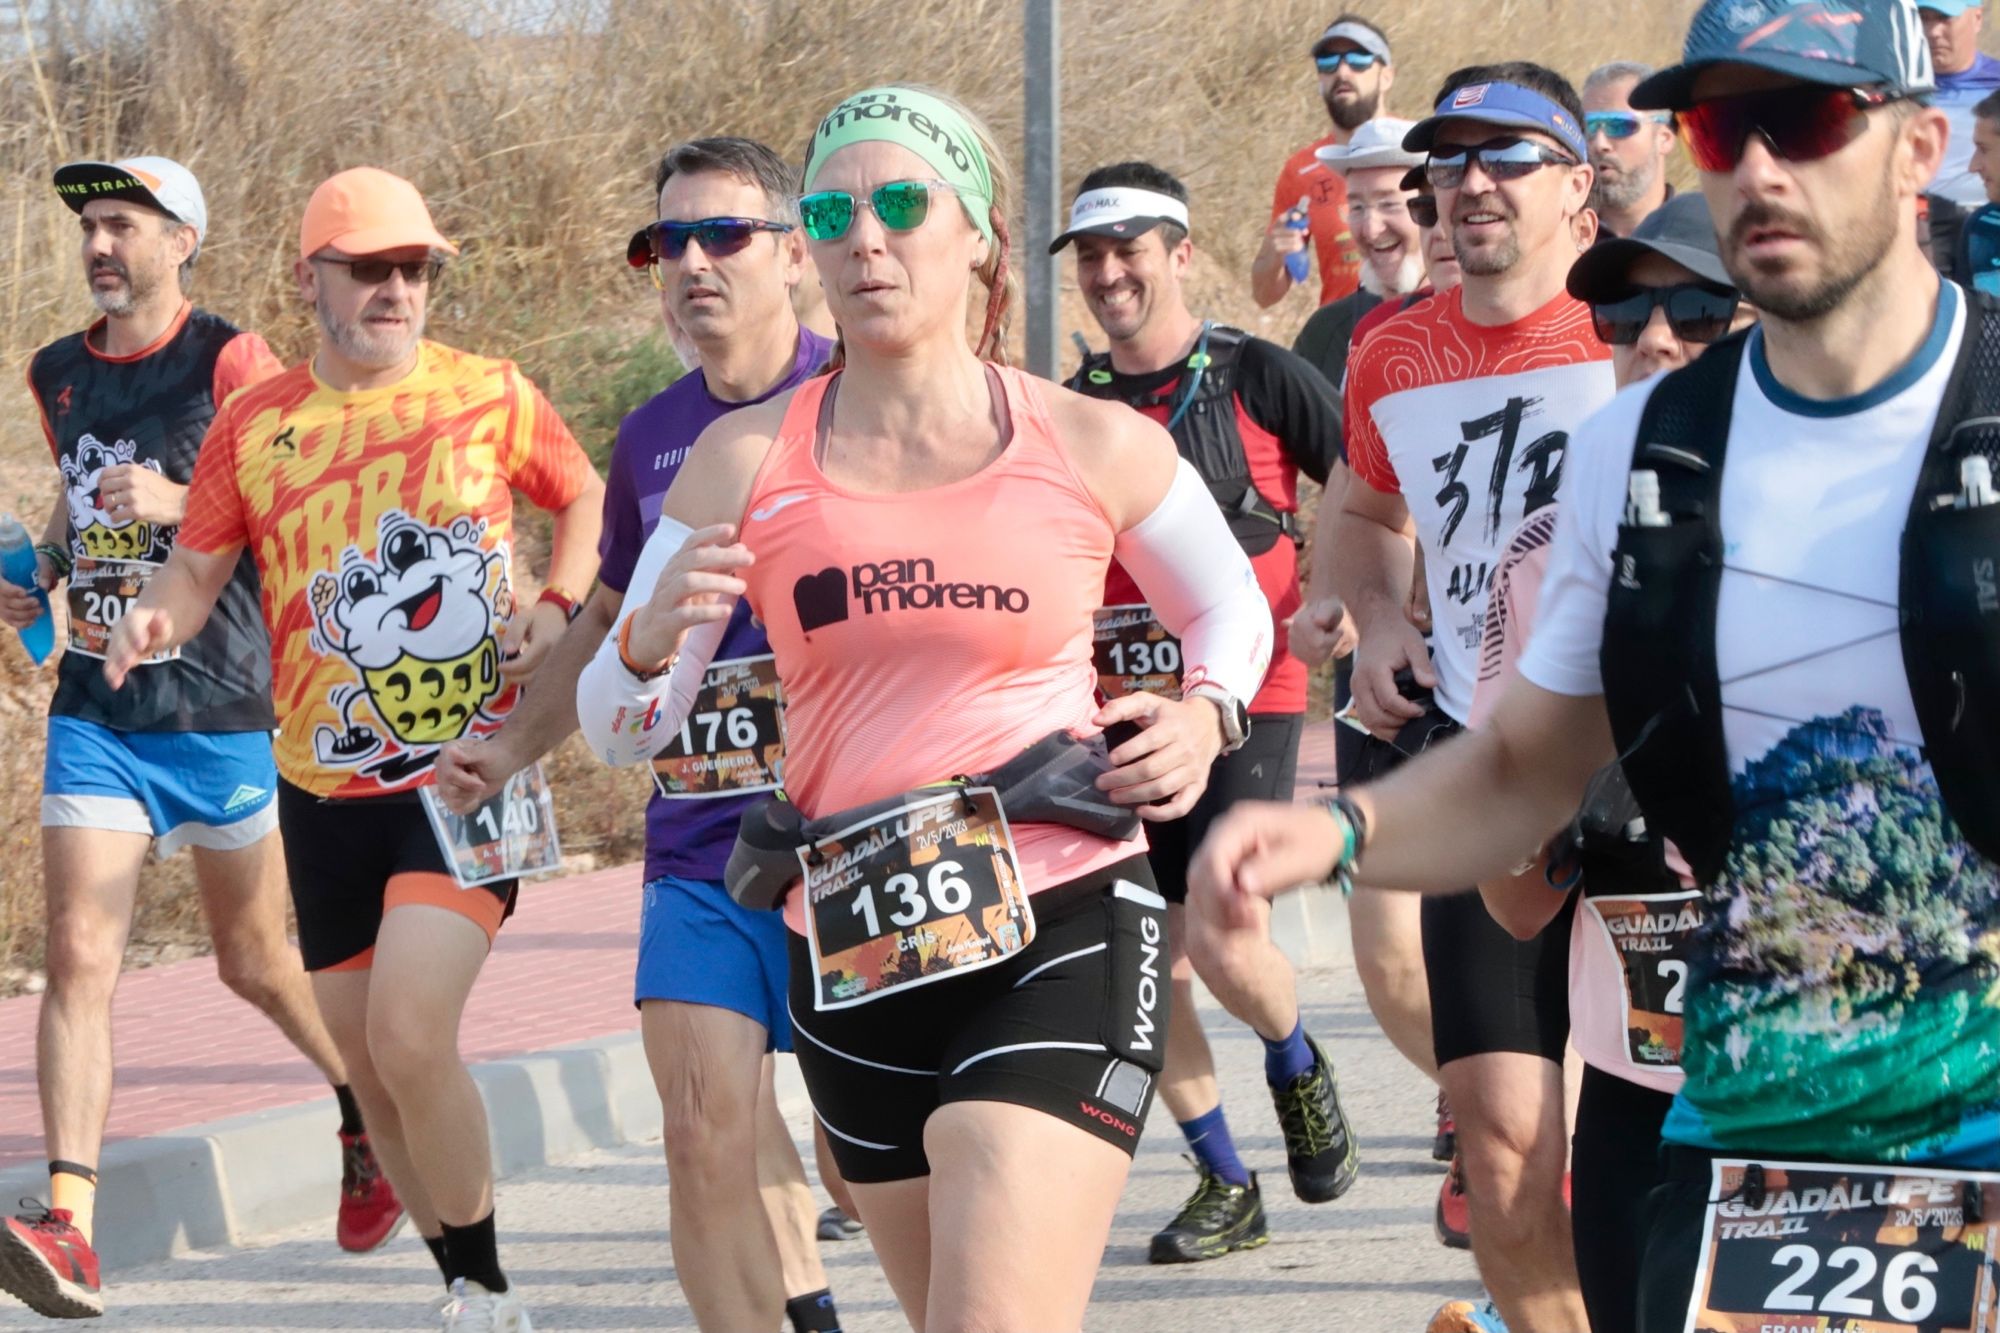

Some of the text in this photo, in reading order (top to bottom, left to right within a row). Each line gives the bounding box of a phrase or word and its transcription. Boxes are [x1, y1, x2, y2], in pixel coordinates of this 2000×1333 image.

[824, 103, 970, 172] moreno
[91, 178, 144, 192] TRAIL
[1095, 198, 1119, 209] MAX
[852, 558, 935, 599] pan
[1446, 562, 1498, 605] ALI
[863, 582, 1030, 614] moreno
[1109, 641, 1180, 675] 130
[681, 707, 758, 755] 176
[692, 755, 754, 774] GUERRERO
[475, 797, 538, 841] 140
[810, 800, 956, 888] GUADALUPE
[812, 866, 864, 903] TRAIL
[851, 860, 972, 937] 136
[896, 931, 937, 952] CRIS
[1619, 936, 1674, 952] TRAIL
[1130, 916, 1161, 1050] WONG
[1081, 1101, 1137, 1137] WONG
[1717, 1178, 1957, 1218] GUADALUPE
[1720, 1216, 1810, 1240] TRAIL
[1763, 1243, 1939, 1322] 226
